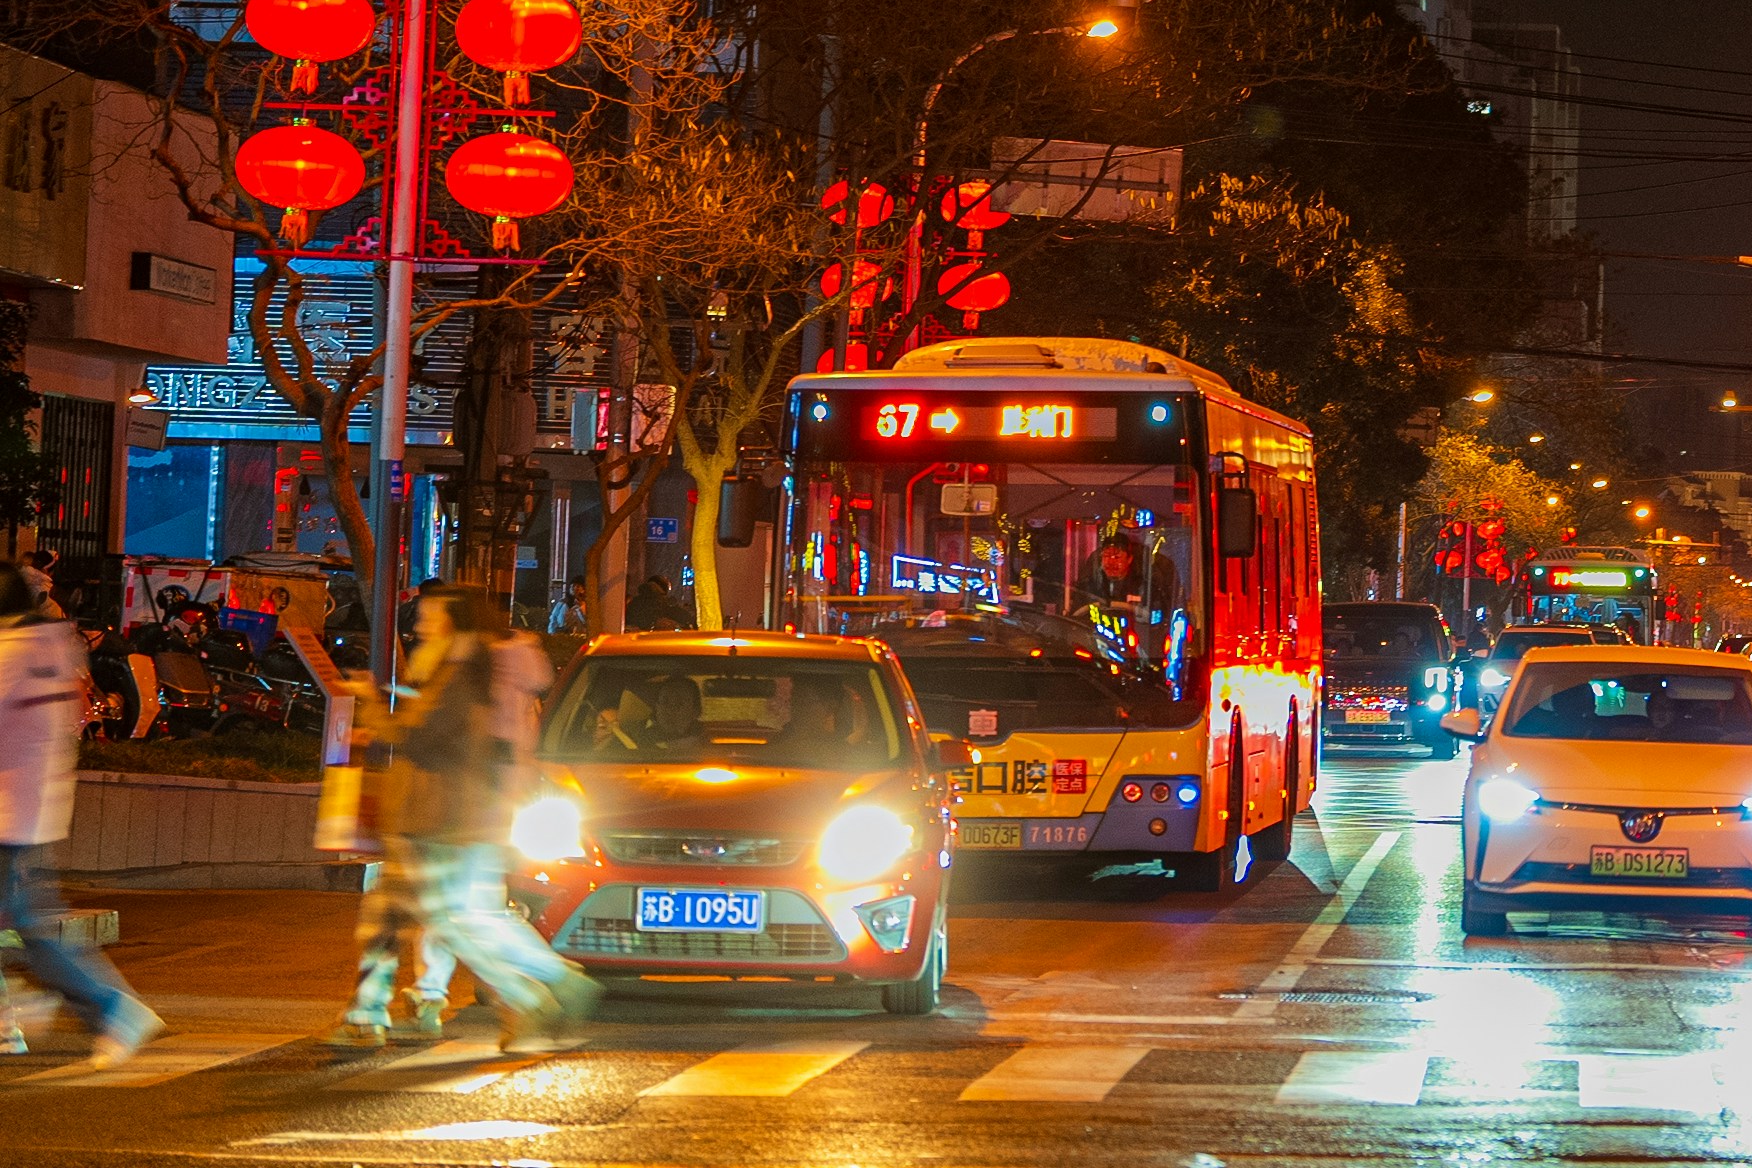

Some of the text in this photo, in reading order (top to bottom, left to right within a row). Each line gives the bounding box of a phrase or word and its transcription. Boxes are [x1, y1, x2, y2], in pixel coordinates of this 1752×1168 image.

[877, 405, 919, 437] 67
[1055, 762, 1084, 776] 医保
[1055, 778, 1084, 793] 定点
[1030, 826, 1087, 843] 71876
